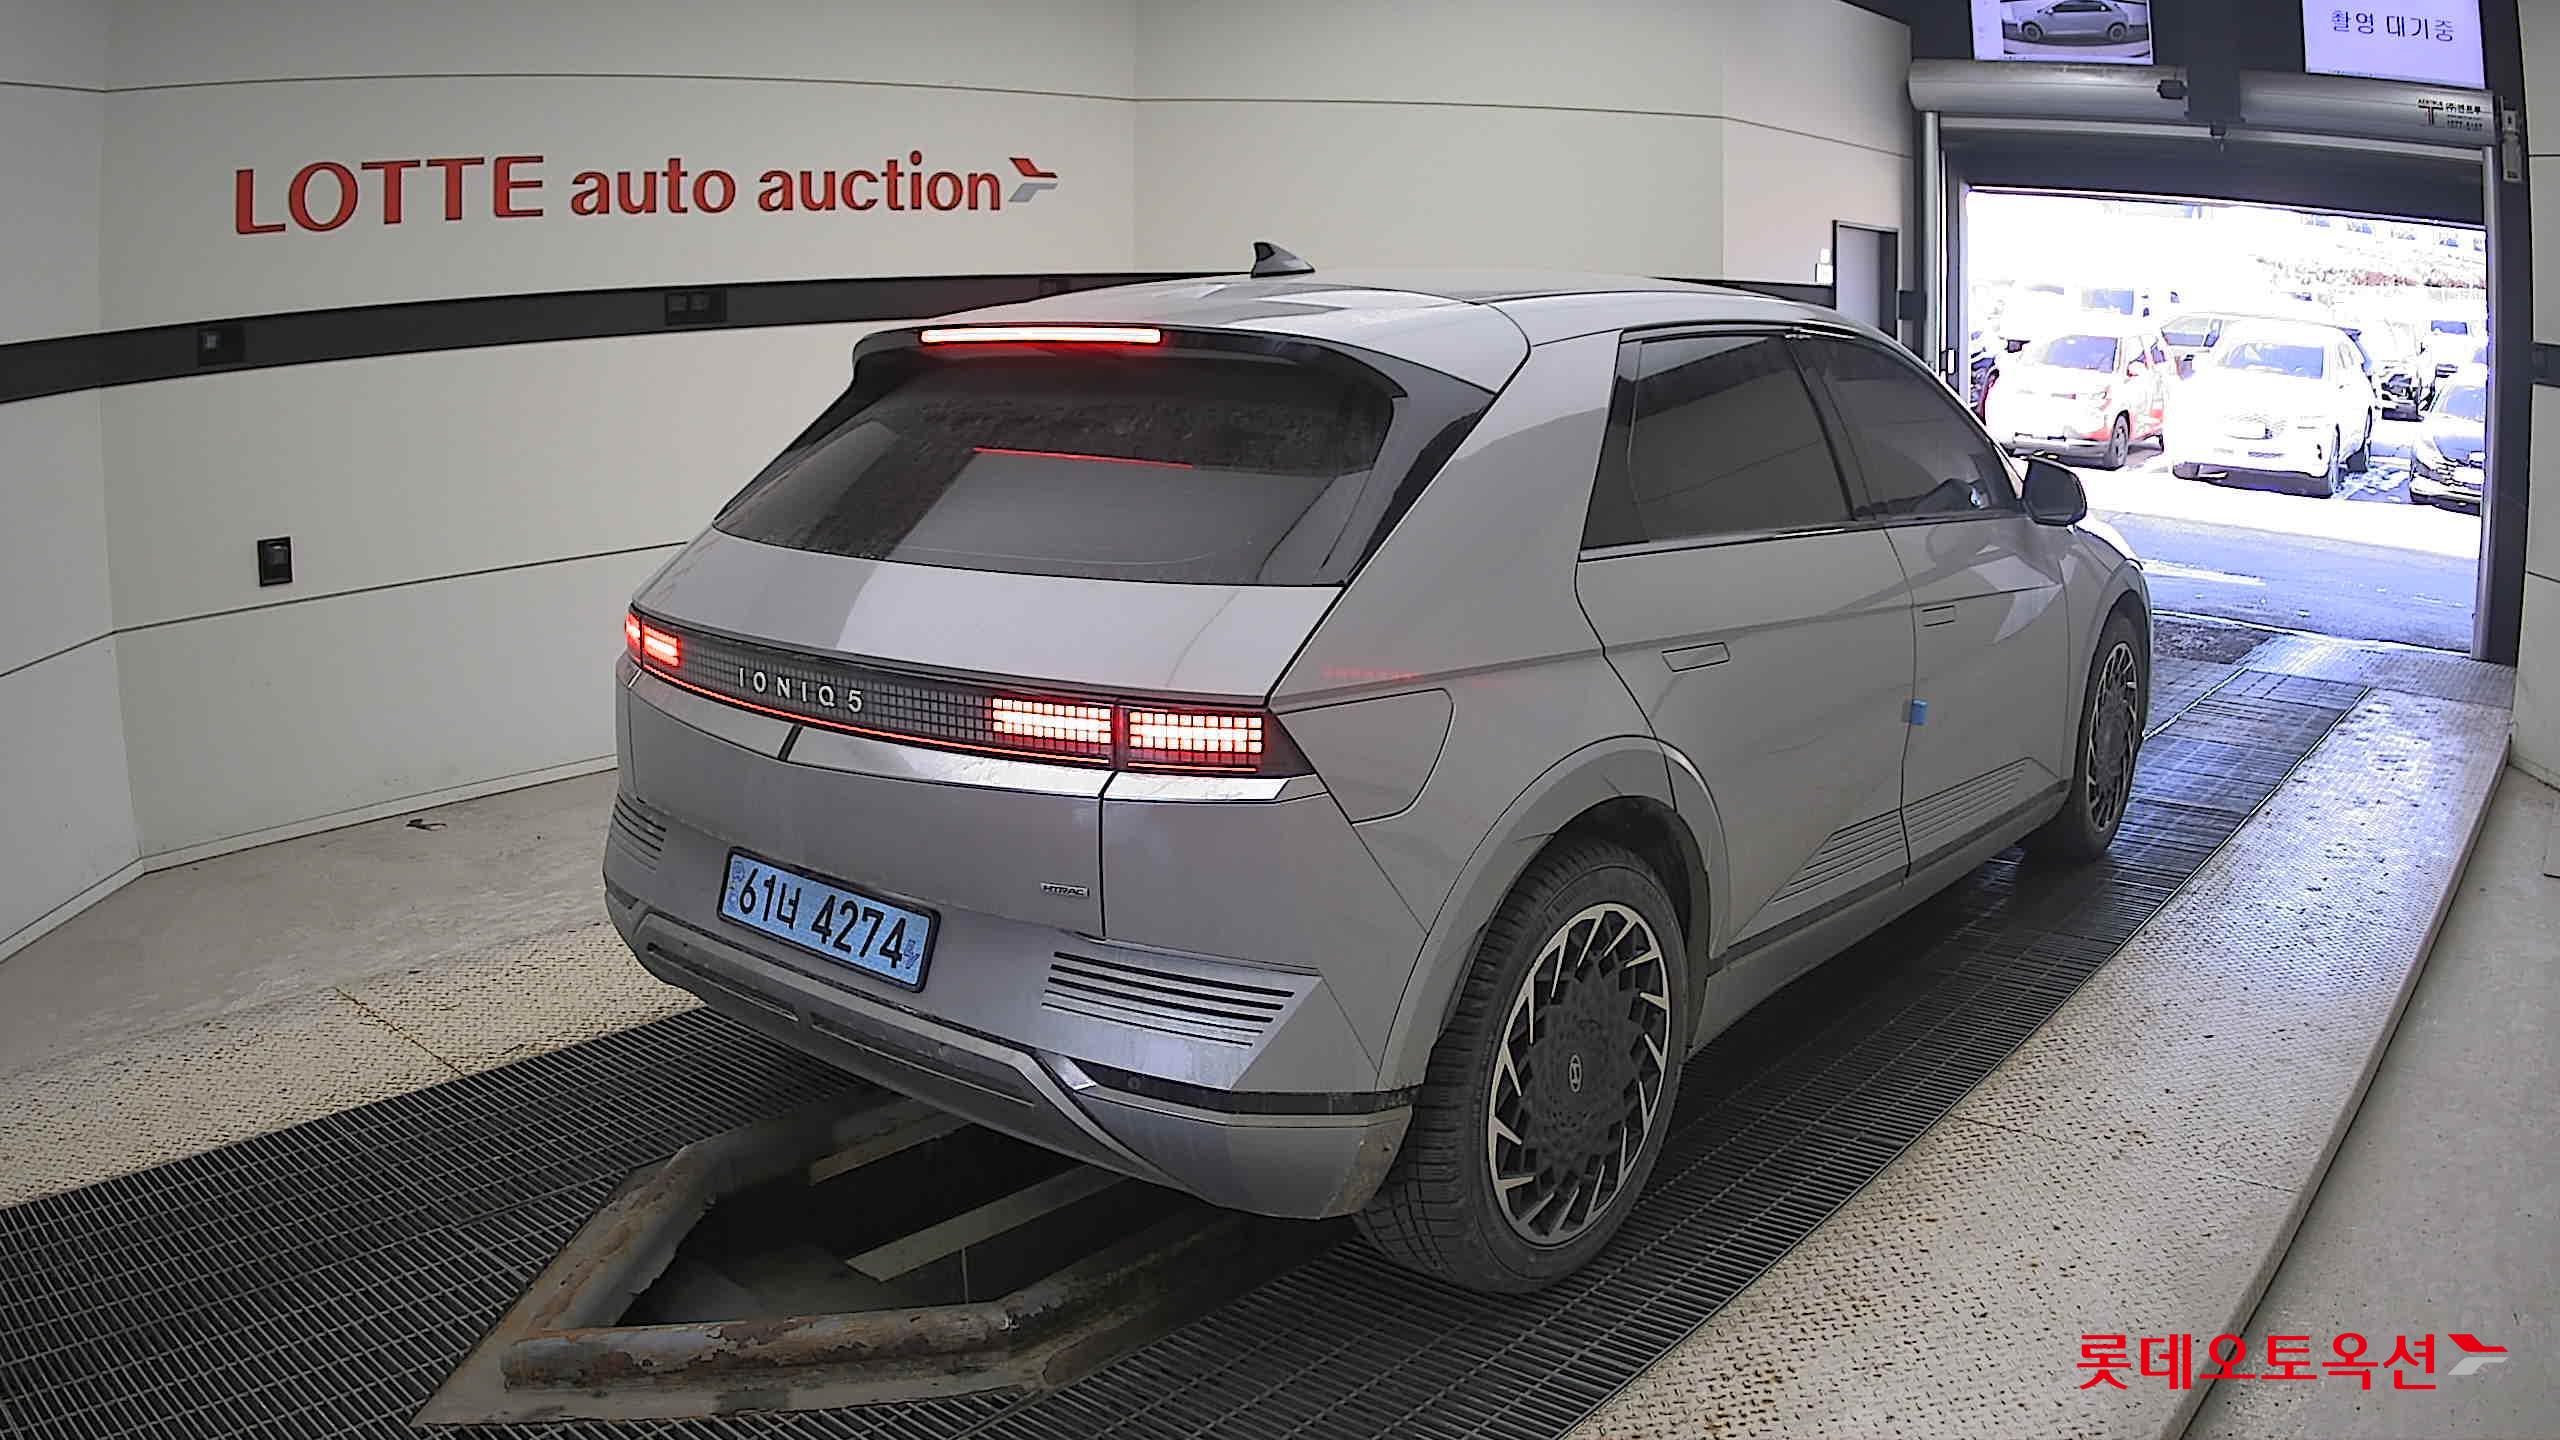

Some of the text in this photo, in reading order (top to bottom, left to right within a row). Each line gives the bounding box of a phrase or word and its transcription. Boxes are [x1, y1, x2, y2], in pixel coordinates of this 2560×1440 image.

[2331, 10, 2454, 42] 촬영 대기중
[235, 150, 1002, 235] LOTTE auto auction
[738, 667, 864, 713] IONIQ 5
[739, 868, 907, 969] 61너 4274
